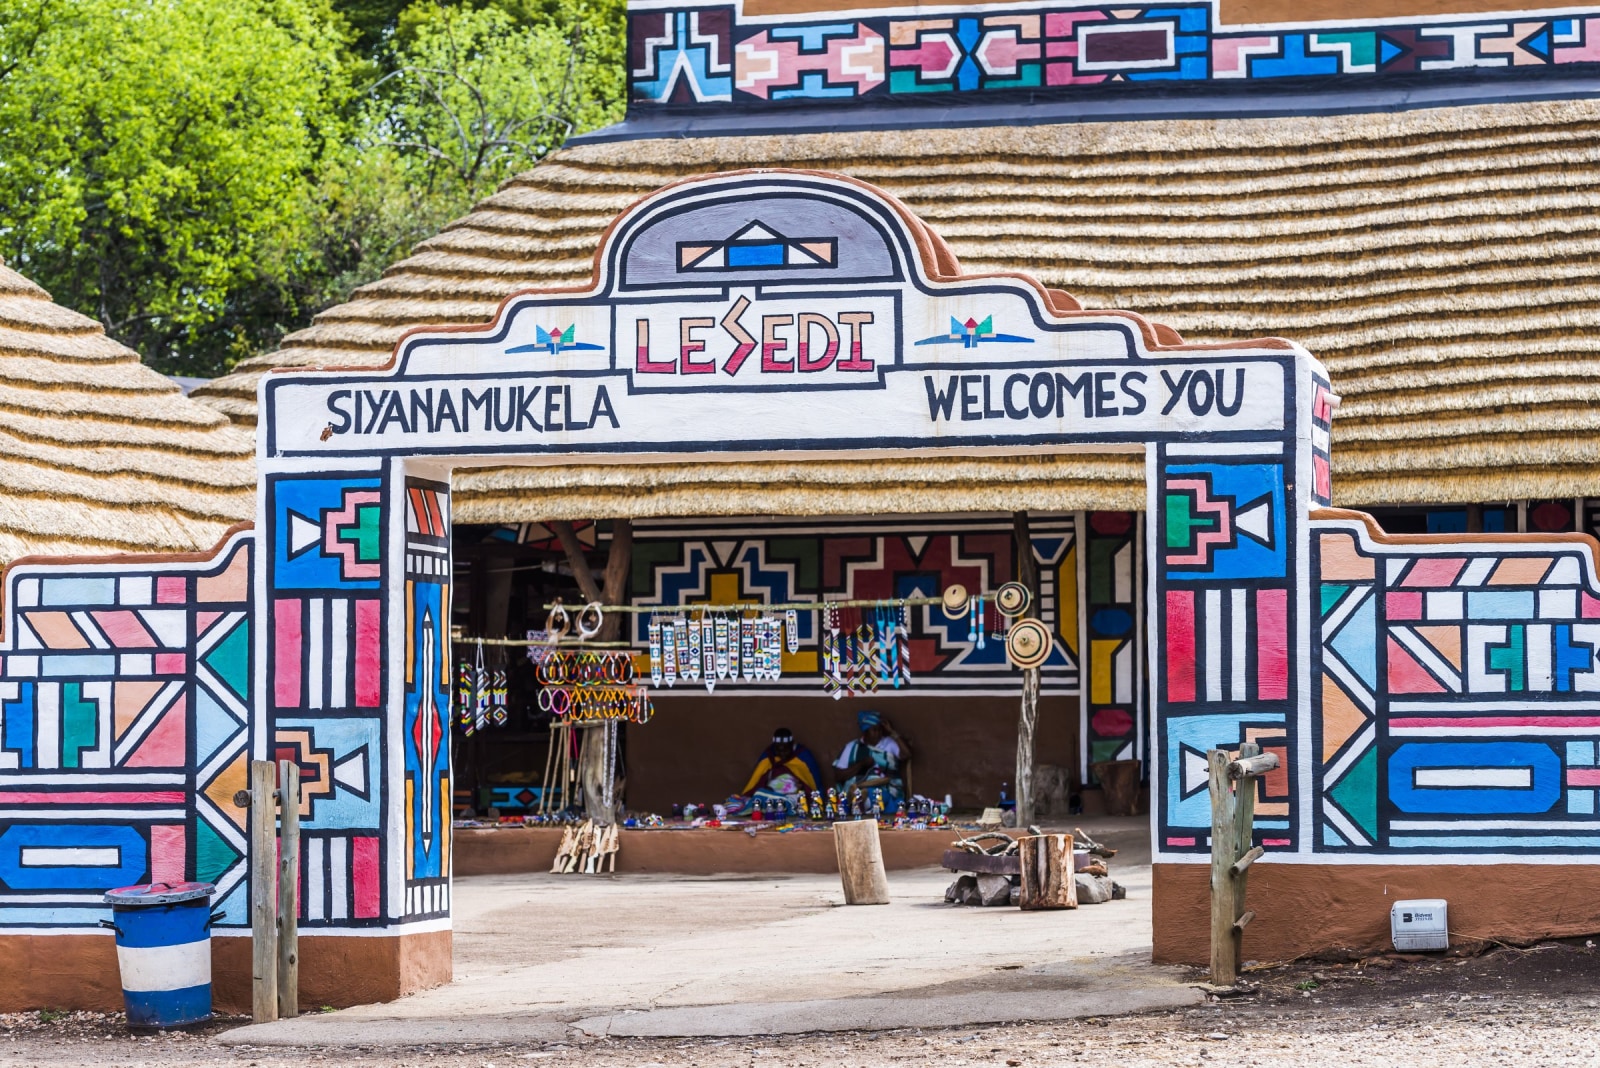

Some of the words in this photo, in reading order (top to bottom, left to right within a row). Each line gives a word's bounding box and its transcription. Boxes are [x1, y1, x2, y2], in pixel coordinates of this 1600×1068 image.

[636, 295, 875, 377] LESEDI
[327, 385, 620, 434] SIYANAMUKELA
[924, 371, 1148, 421] WELCOMES
[1160, 368, 1245, 417] YOU
